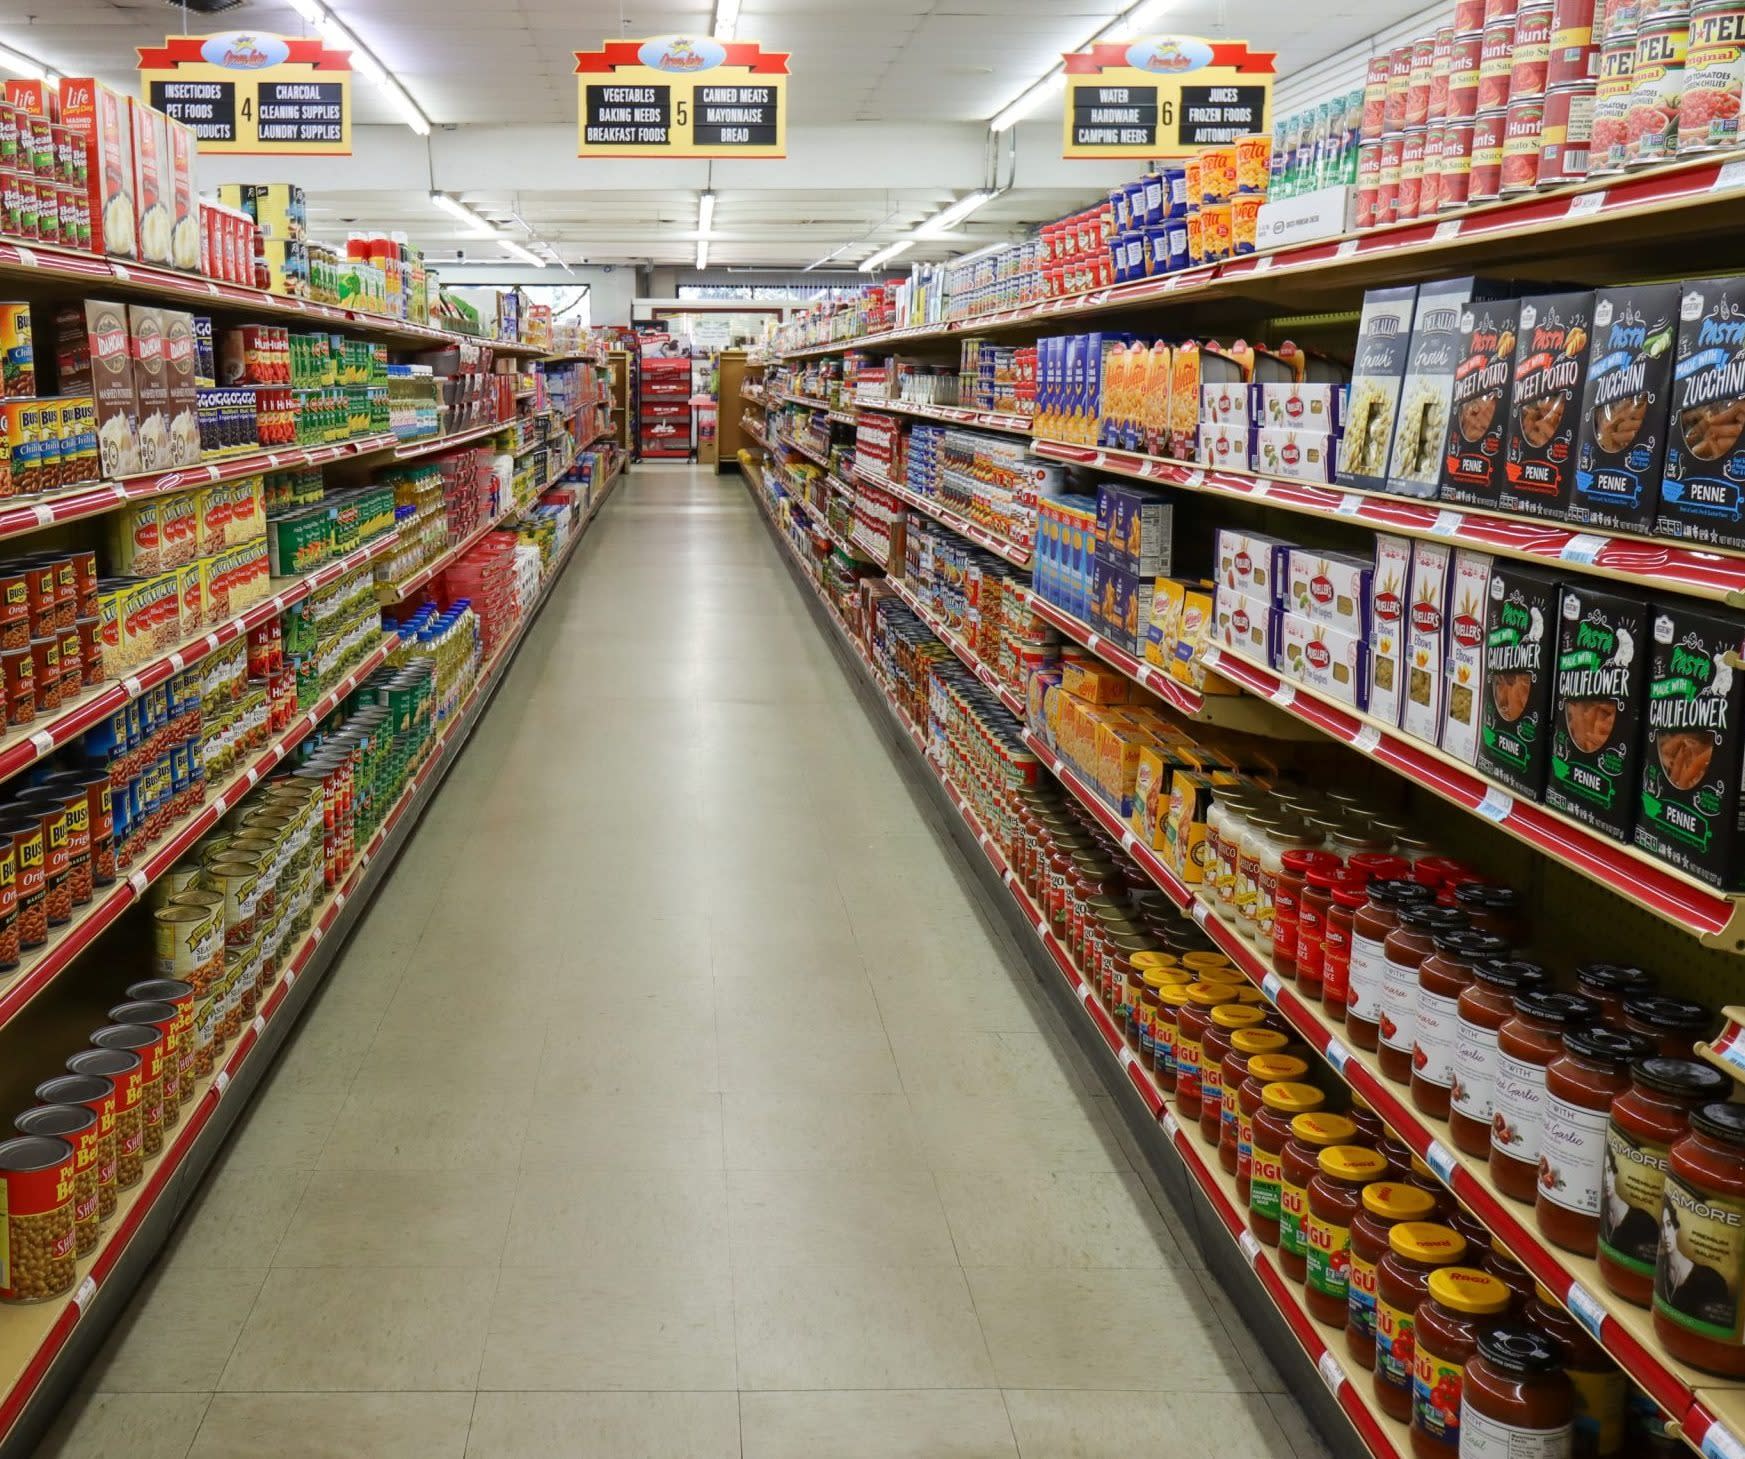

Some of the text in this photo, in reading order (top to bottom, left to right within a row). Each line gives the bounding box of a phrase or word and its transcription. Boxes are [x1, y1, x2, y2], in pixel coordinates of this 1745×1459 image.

[14, 88, 36, 110] Life
[66, 86, 89, 109] Life
[164, 84, 222, 99] INSECTICIDES
[275, 85, 321, 99] CHARCOAL
[603, 88, 655, 103] VEGETABLES
[703, 88, 769, 103] CANNED MEATS
[1099, 89, 1129, 103] WATER
[1208, 88, 1239, 103] JUICES
[166, 103, 213, 118] PET FOODS
[240, 97, 252, 122] 4
[259, 105, 340, 119] CLEANING SUPPLIES
[599, 108, 661, 122] BAKING NEEDS
[676, 101, 687, 126] 5
[706, 108, 763, 123] MAYONNAISE
[1091, 109, 1140, 123] HARDWARE
[1162, 101, 1173, 126] 6
[1188, 107, 1252, 122] FROZEN FOODS
[258, 124, 341, 139] LAUNDRY SUPPLIES
[587, 128, 666, 142] BREAKFAST FOODS
[720, 128, 749, 142] BREAD
[1078, 129, 1148, 143] CAMPING NEEDS
[1608, 323, 1646, 349] PASTA
[1454, 361, 1508, 402] SWEET POTATO
[1513, 360, 1579, 404] SWEET POTATO
[1595, 362, 1646, 405] ZUCCHINI
[1462, 459, 1482, 473] PENNE
[1525, 466, 1550, 481] PENNE
[1598, 474, 1627, 492] PENNE
[1690, 484, 1726, 503] PENNE
[1502, 601, 1529, 630] PASTA
[1577, 620, 1615, 653] PASTA
[1456, 648, 1474, 665] Elbows
[1487, 642, 1541, 671] CAULIFLOWER
[1671, 645, 1711, 682] PASTA
[1559, 668, 1630, 698] CAULIFLOWER
[1652, 681, 1670, 698] MADE
[1649, 697, 1729, 730] CAULIFLOWER
[1498, 735, 1519, 756] PENNE
[1573, 767, 1601, 792] PENNE
[1666, 805, 1697, 834] PENNE
[1508, 1065, 1533, 1078] WITH
[1553, 1104, 1576, 1119] WITH
